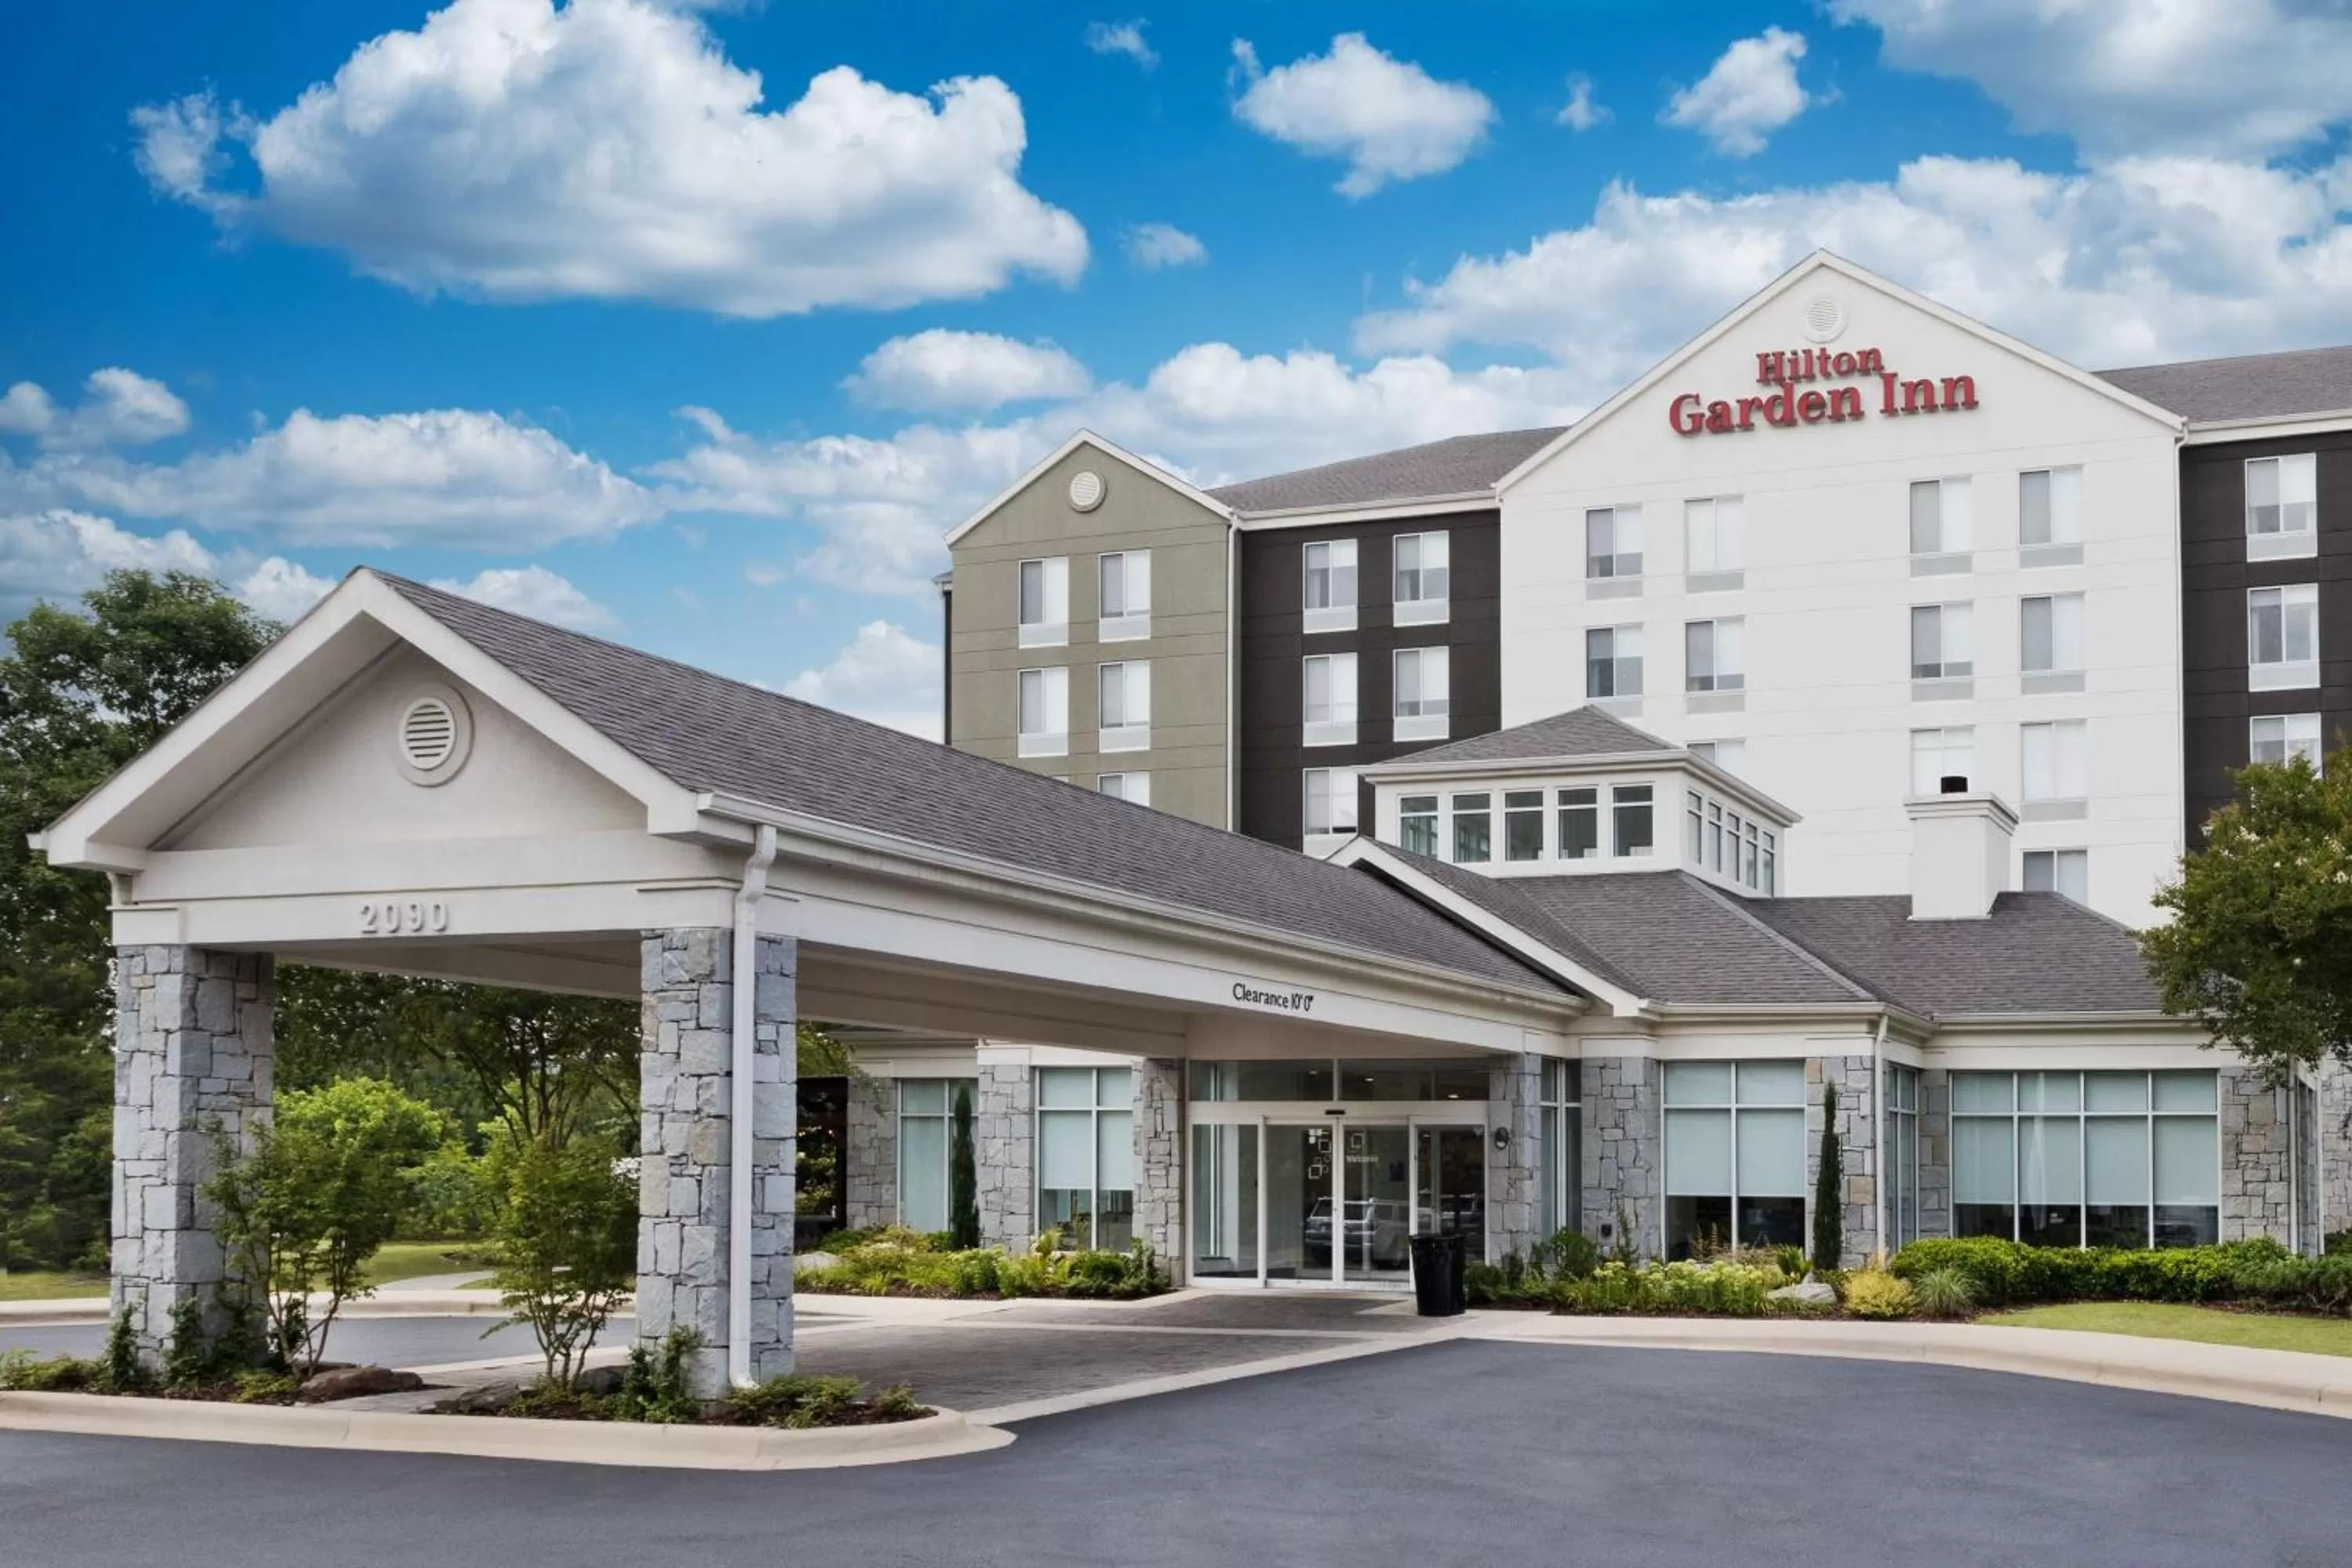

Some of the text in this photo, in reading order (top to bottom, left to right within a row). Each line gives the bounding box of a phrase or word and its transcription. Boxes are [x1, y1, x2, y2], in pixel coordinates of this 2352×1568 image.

[1755, 347, 1885, 385] Hilton
[1669, 372, 1980, 436] Garden Inn
[1232, 982, 1289, 1009] Clearance
